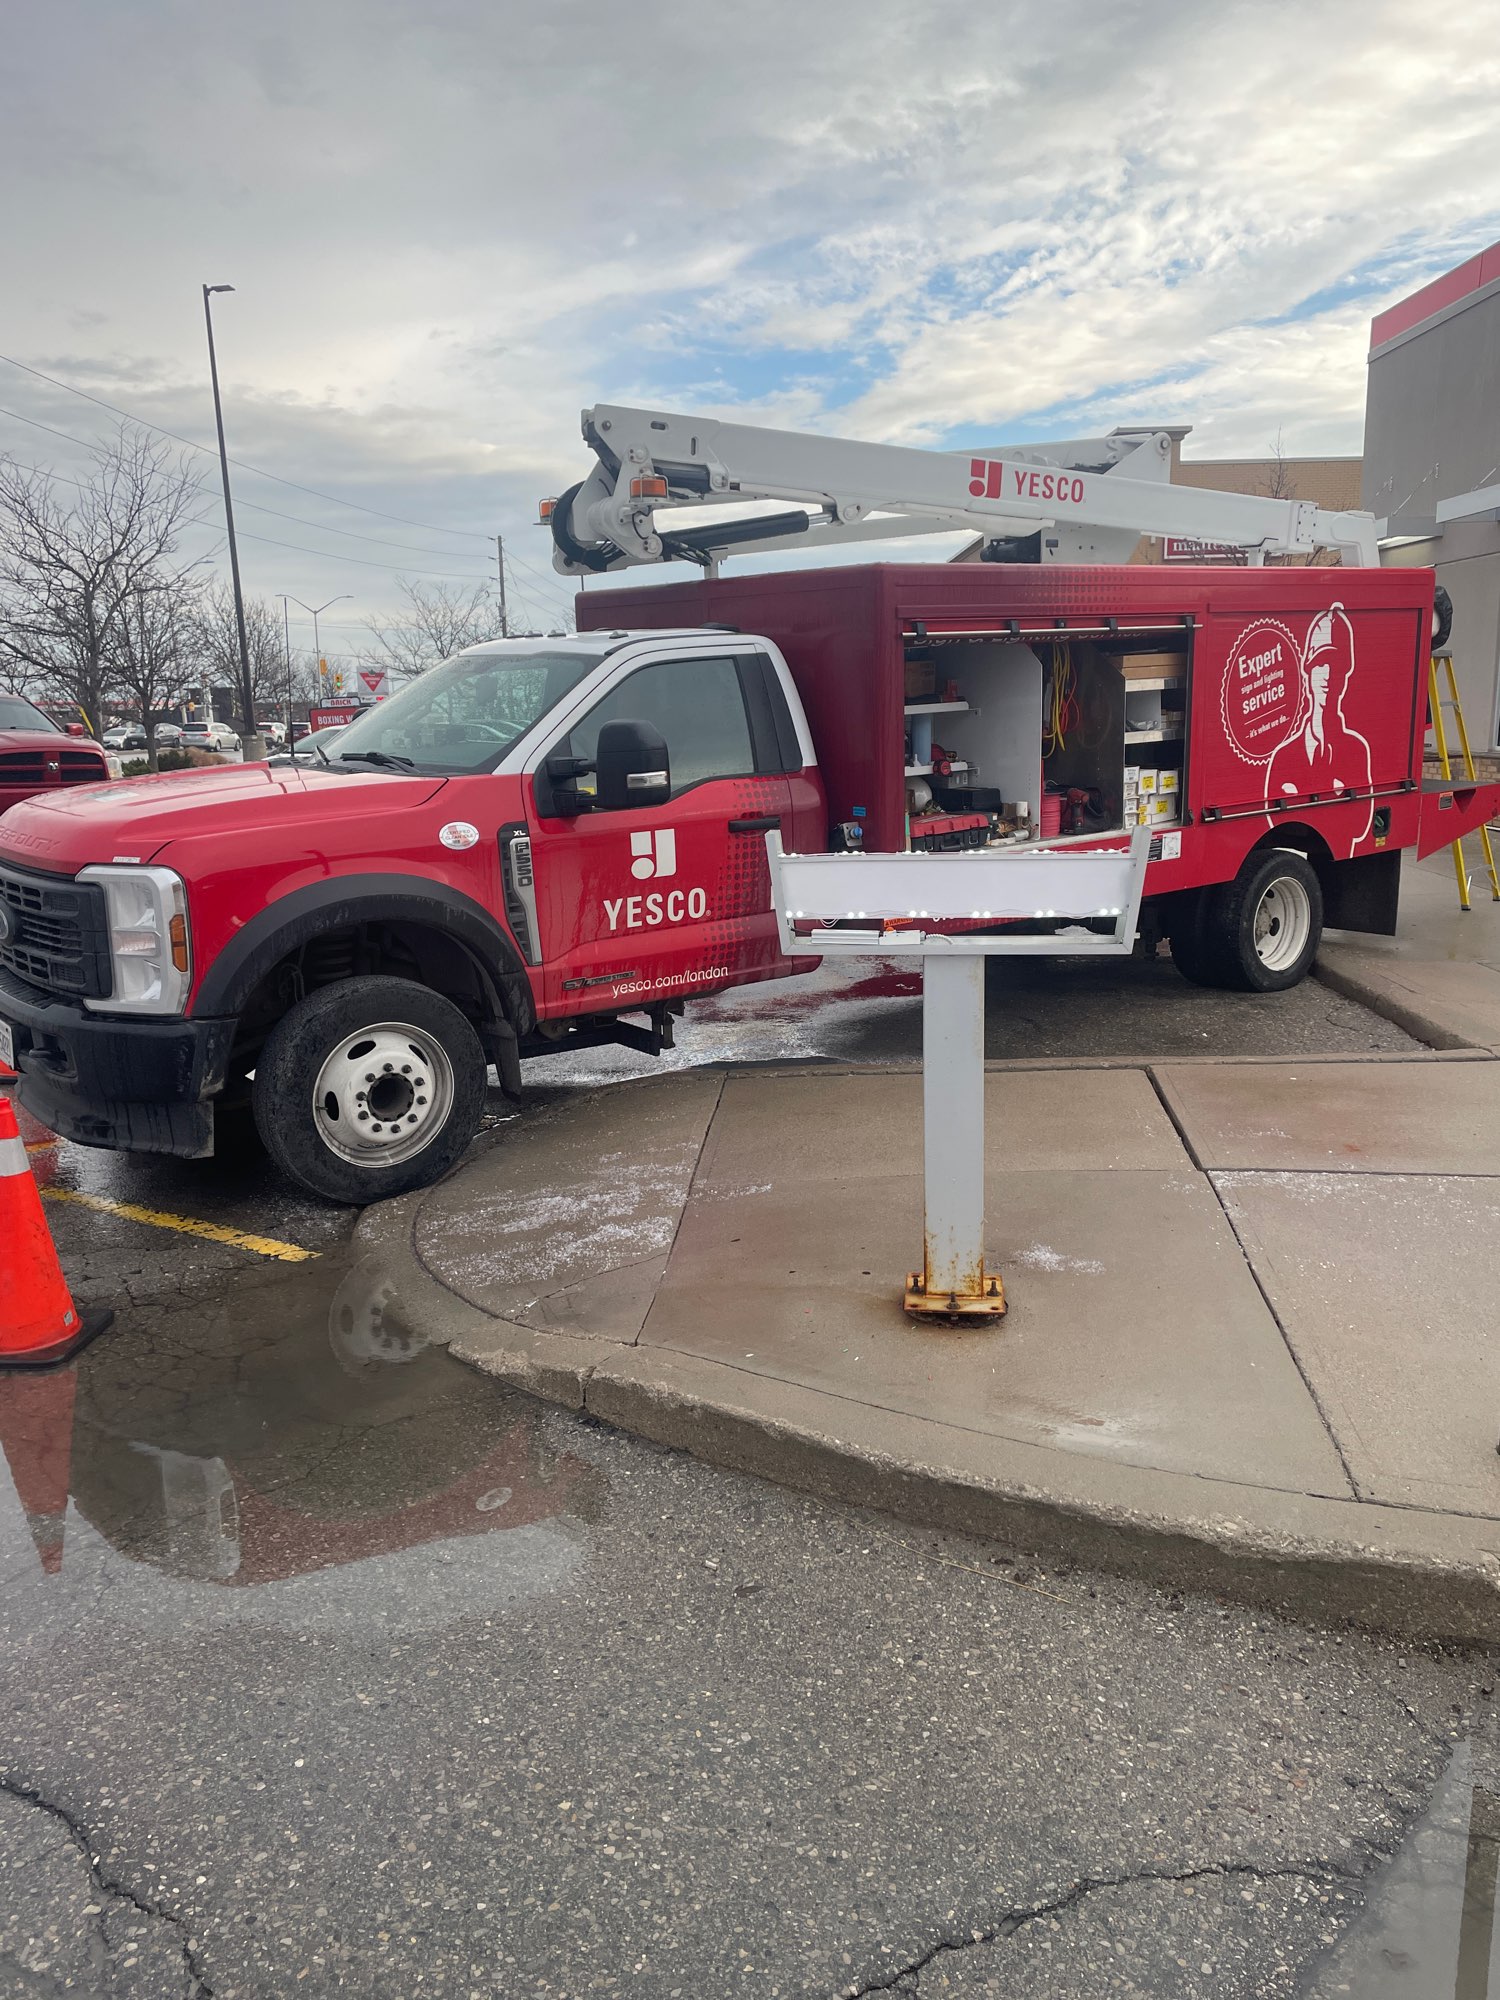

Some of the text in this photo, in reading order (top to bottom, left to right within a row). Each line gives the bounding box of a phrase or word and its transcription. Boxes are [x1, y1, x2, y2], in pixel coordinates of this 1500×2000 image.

[1014, 470, 1084, 503] YESCO
[1239, 643, 1283, 679] Expert
[1242, 684, 1285, 714] service
[317, 715, 345, 725] BOXING
[15, 833, 61, 852] DUTY
[515, 842, 533, 887] F550
[603, 887, 706, 930] YESCO
[612, 966, 729, 999] yesco.com/london
